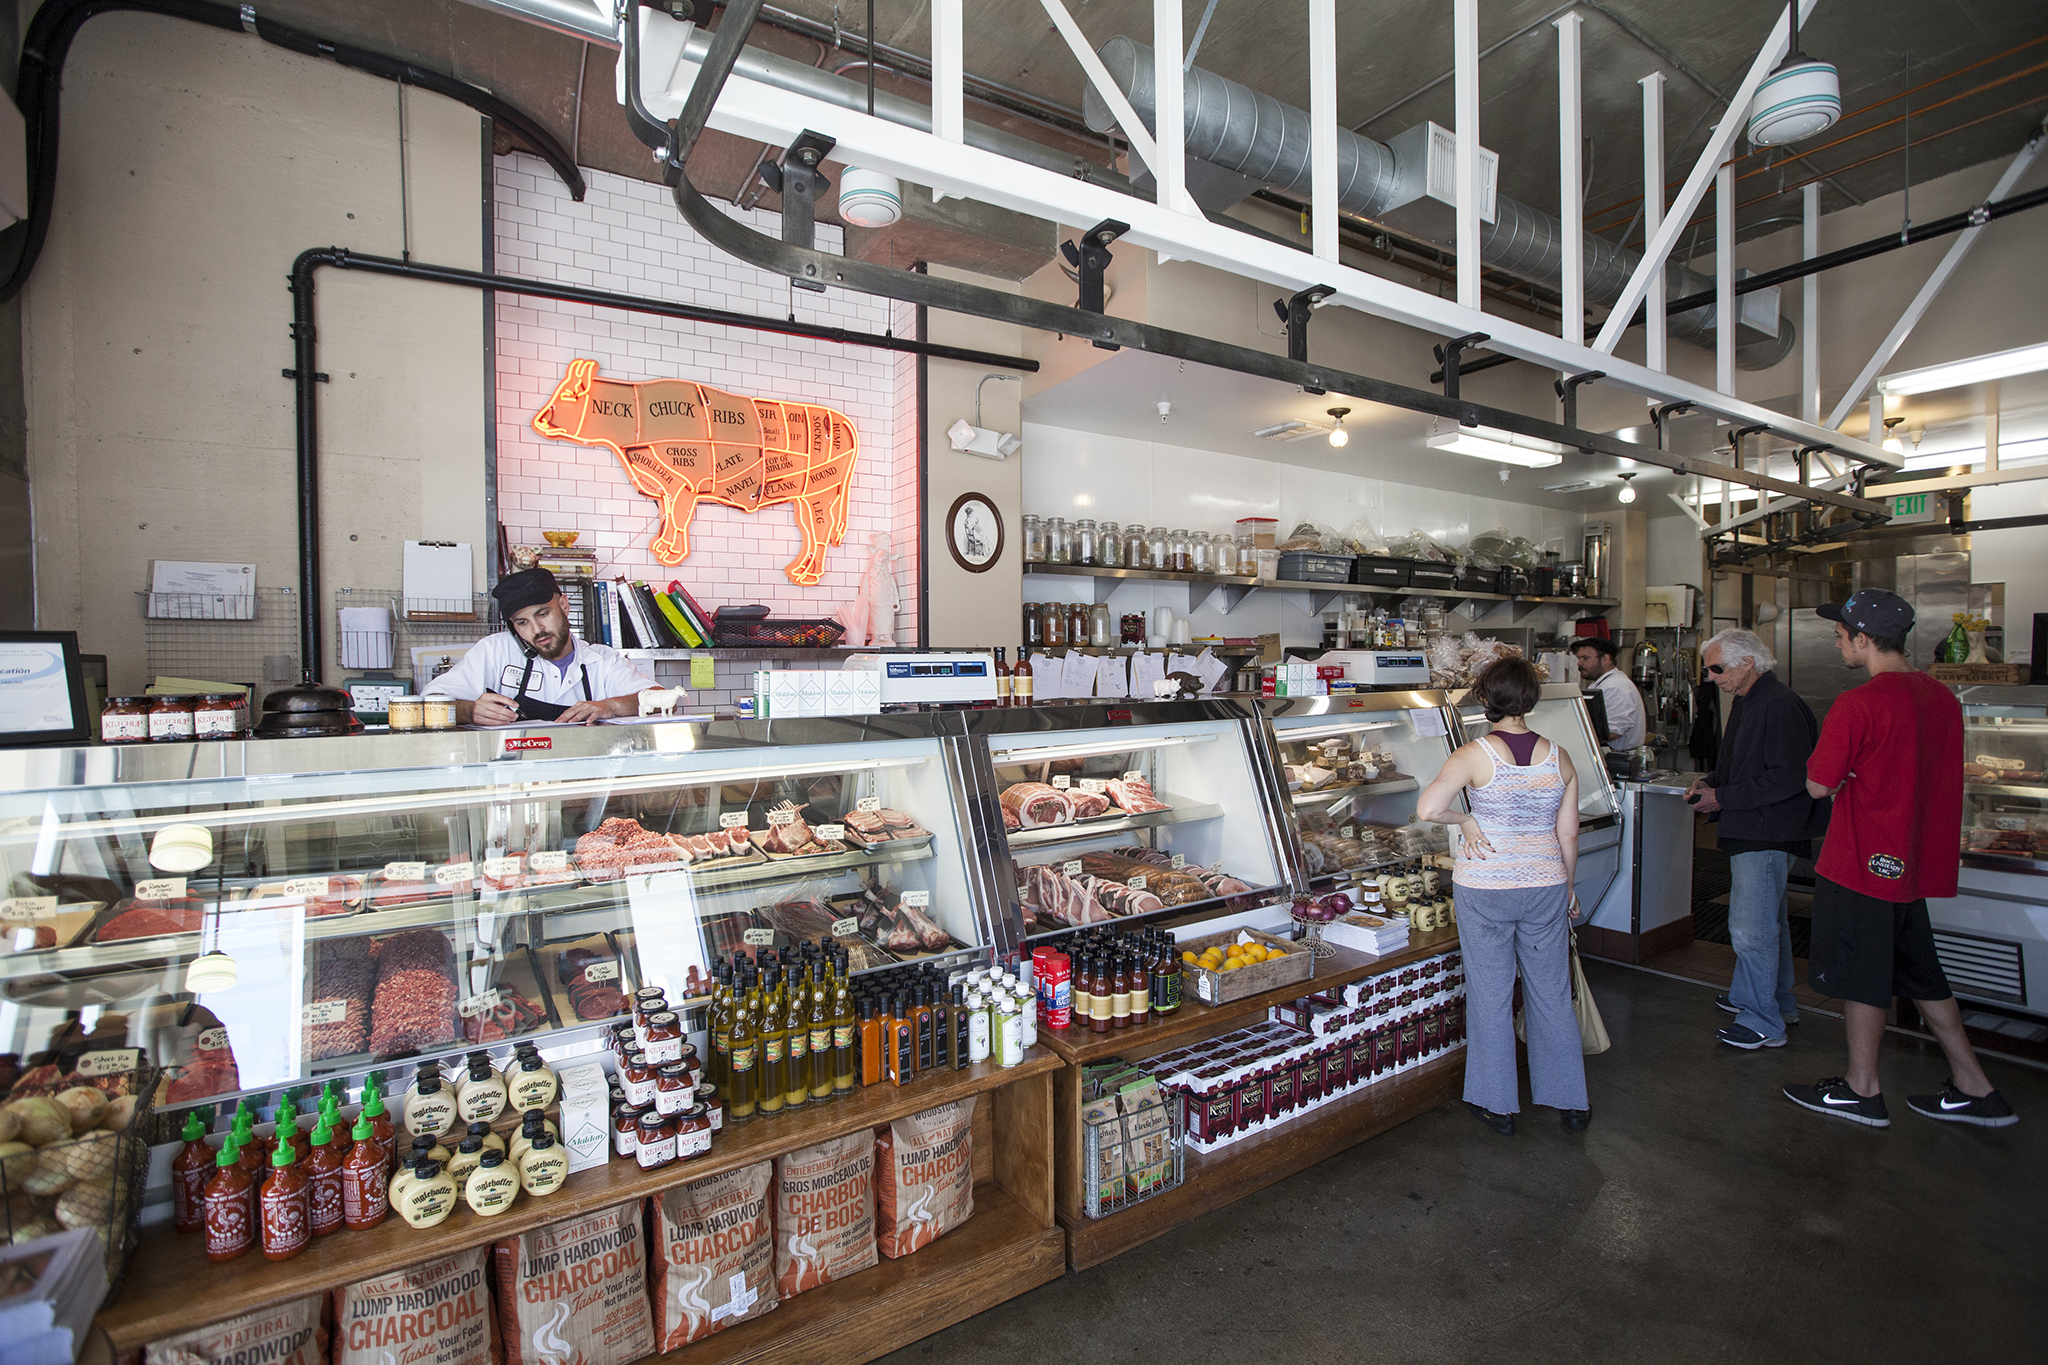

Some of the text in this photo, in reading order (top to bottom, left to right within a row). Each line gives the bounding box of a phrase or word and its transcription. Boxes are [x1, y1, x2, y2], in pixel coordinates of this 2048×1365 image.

[592, 399, 745, 425] NECK CHUCK RIBS
[758, 409, 777, 420] SIR
[813, 416, 821, 453] SOCKET
[666, 447, 697, 457] CROSS
[780, 454, 789, 463] OF
[632, 453, 674, 484] SHOULDER
[672, 457, 695, 467] RIBS
[765, 461, 794, 473] SIRLOIN
[809, 466, 838, 483] ROUND
[726, 476, 757, 496] NAVEL
[765, 481, 797, 495] FLANK
[812, 501, 825, 524] LEG
[1895, 494, 1927, 515] EXIT
[1981, 674, 2009, 682] LAND
[105, 719, 144, 728] KETCHUP
[153, 718, 190, 727] KETCHUP
[197, 715, 233, 724] KETCHUP
[507, 739, 550, 749] McCray
[648, 1042, 679, 1055] KETCHUP
[518, 1080, 553, 1093] inglehoffer
[1273, 1077, 1292, 1092] KOSHER
[466, 1090, 502, 1105] inglehoffer
[663, 1091, 693, 1104] KETCHUP
[1242, 1088, 1262, 1104] KOSHER
[1251, 1094, 1262, 1103] SALT
[412, 1105, 450, 1119] inglehoffer
[1209, 1101, 1232, 1116] KOSHER
[1218, 1107, 1230, 1116] SALT
[572, 1134, 603, 1147] Maldon
[682, 1132, 711, 1147] KETCHUP
[913, 1136, 928, 1147] ALL
[644, 1142, 675, 1157] KETCHUP
[901, 1148, 930, 1166] LUMP
[526, 1159, 563, 1173] inglehoffer
[782, 1156, 871, 1193] GROS MORCEAUX DE
[786, 1159, 835, 1176] ENTIÈREMENT
[474, 1178, 513, 1192] inglehoffer
[789, 1171, 868, 1215] CHARBON
[935, 1176, 957, 1196] Taste
[412, 1186, 452, 1205] inglehoffer
[682, 1186, 755, 1220] ALL NATURAL
[797, 1198, 864, 1238] DE BOIS
[538, 1214, 620, 1251] ALL NATURAL
[670, 1221, 704, 1242] LUMP
[671, 1212, 769, 1265] CHARCOAL
[523, 1222, 637, 1279] LUMP HARDWOOD
[713, 1256, 743, 1280] Taste
[750, 1257, 760, 1268] the
[366, 1260, 460, 1294] ALL NATURAL
[523, 1242, 641, 1304] CHARCOAL
[353, 1268, 481, 1319] LUMP HARDWOOD
[571, 1268, 642, 1317] Taste Your Food
[604, 1296, 616, 1308] Not
[617, 1290, 628, 1301] the
[349, 1290, 484, 1351] CHARCOAL
[224, 1315, 293, 1349] NATURAL
[604, 1328, 625, 1346] Quick
[399, 1319, 483, 1365] Taste Your Food
[436, 1333, 484, 1364] Not the Fuel!
